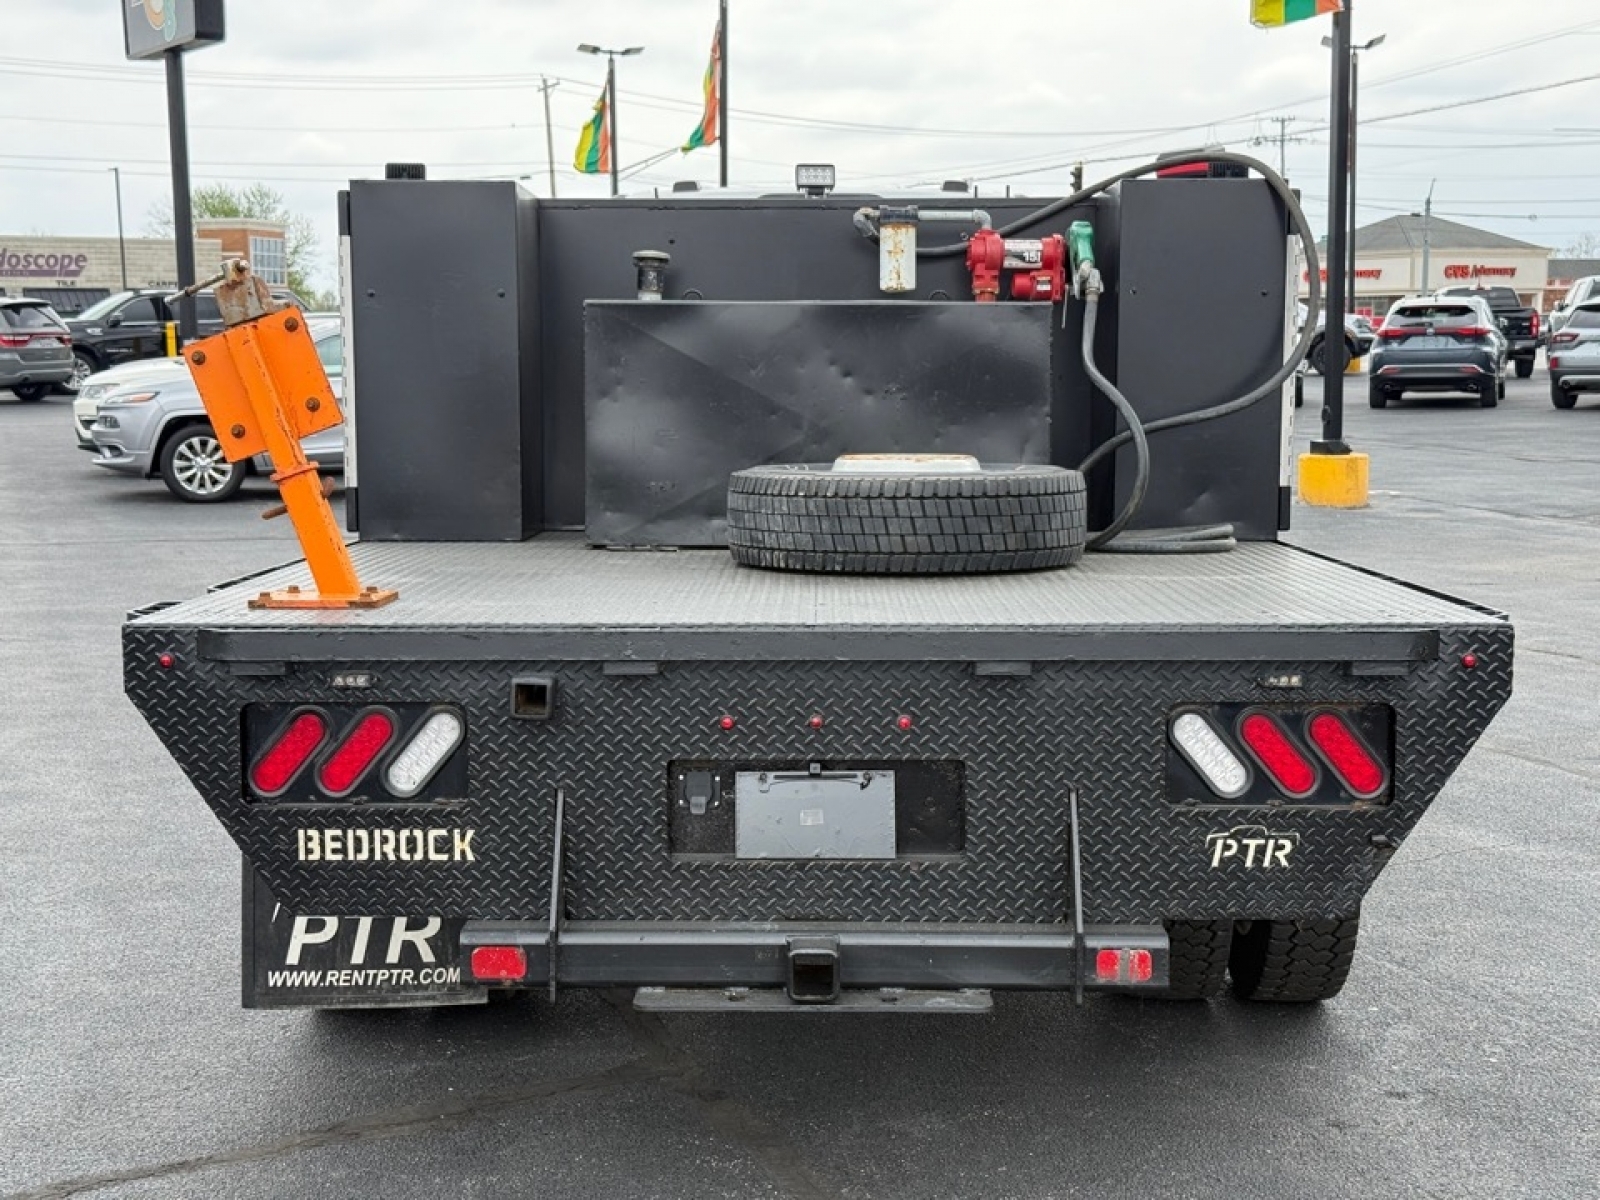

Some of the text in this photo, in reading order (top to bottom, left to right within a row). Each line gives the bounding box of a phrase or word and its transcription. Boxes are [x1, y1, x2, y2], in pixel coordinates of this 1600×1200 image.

[297, 828, 476, 862] BEDROCK
[1211, 838, 1293, 868] PTR
[285, 915, 442, 966] PTR
[267, 967, 461, 988] WWW.RENTPTR.COM
